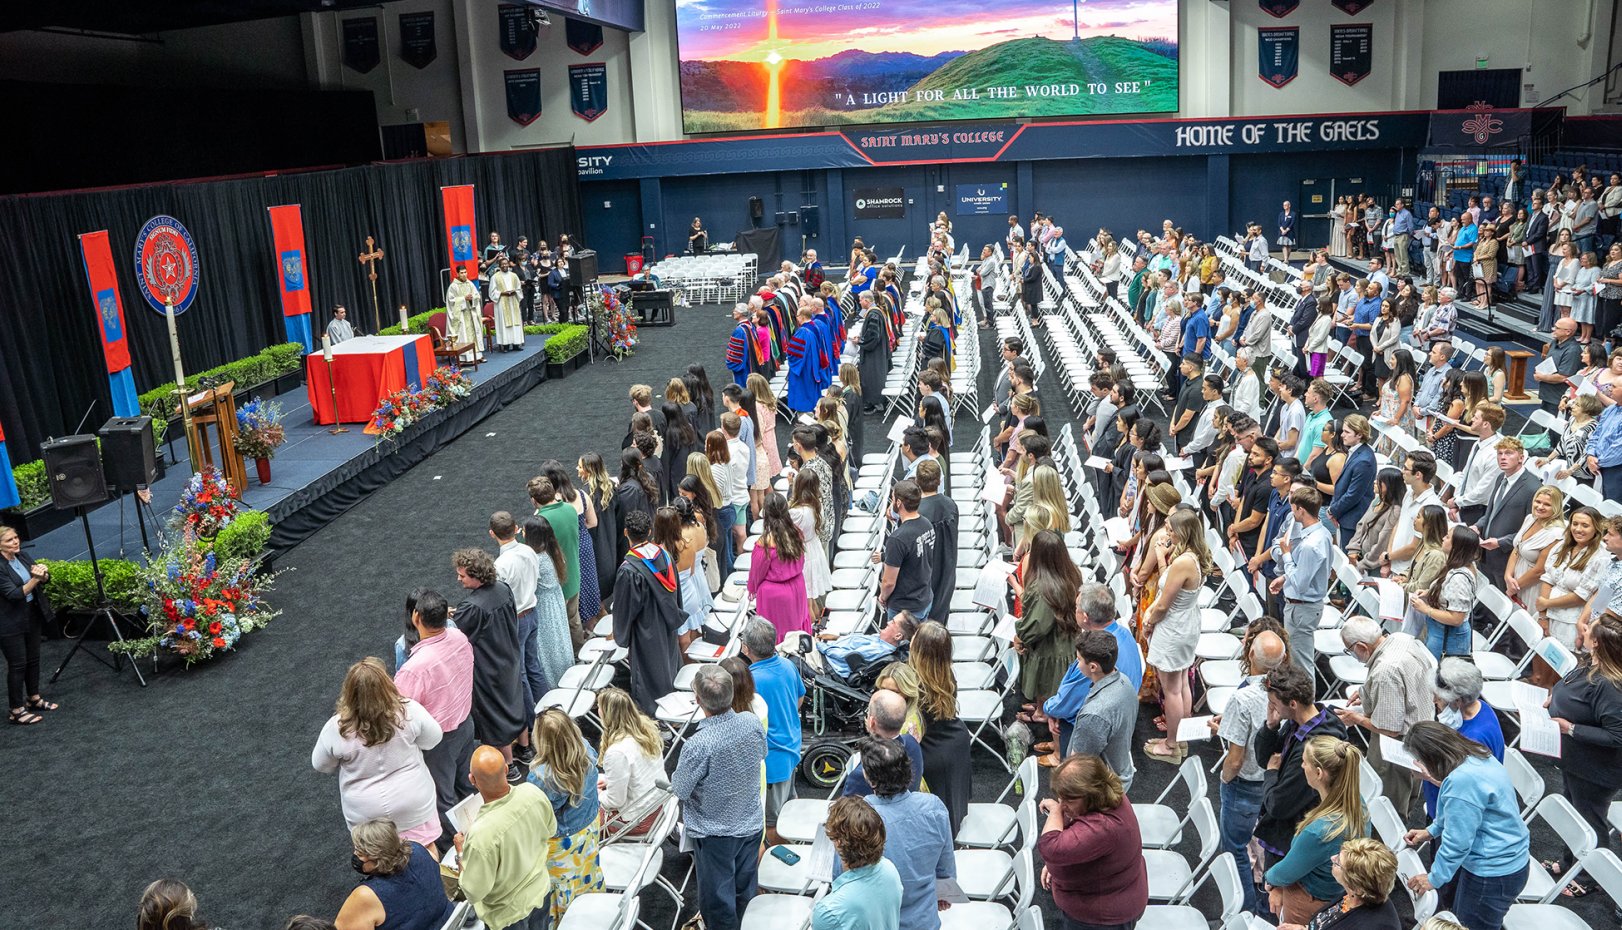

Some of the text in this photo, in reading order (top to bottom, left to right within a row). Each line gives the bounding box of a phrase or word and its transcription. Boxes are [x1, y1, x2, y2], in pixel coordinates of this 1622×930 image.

[700, 12, 746, 20] Commencement
[748, 10, 768, 18] Liturgy
[794, 6, 814, 15] Mary's
[815, 5, 836, 14] College
[856, 2, 863, 10] of
[725, 22, 742, 30] 2022
[863, 91, 909, 105] LIGHT
[916, 89, 945, 102] FOR
[953, 88, 980, 101] ALL
[987, 86, 1017, 99] THE
[1024, 83, 1080, 98] WORLD
[1087, 82, 1107, 95] TO
[861, 130, 1004, 148] SAINT MARY'S COLLEGE
[1174, 120, 1380, 147] HOME OF THE GAELS
[578, 156, 613, 167] SITY
[147, 217, 173, 232] COLLEGE
[137, 231, 148, 264] MARY'S
[183, 231, 199, 285] CALIFORNIA
[138, 271, 152, 300] SAINT
